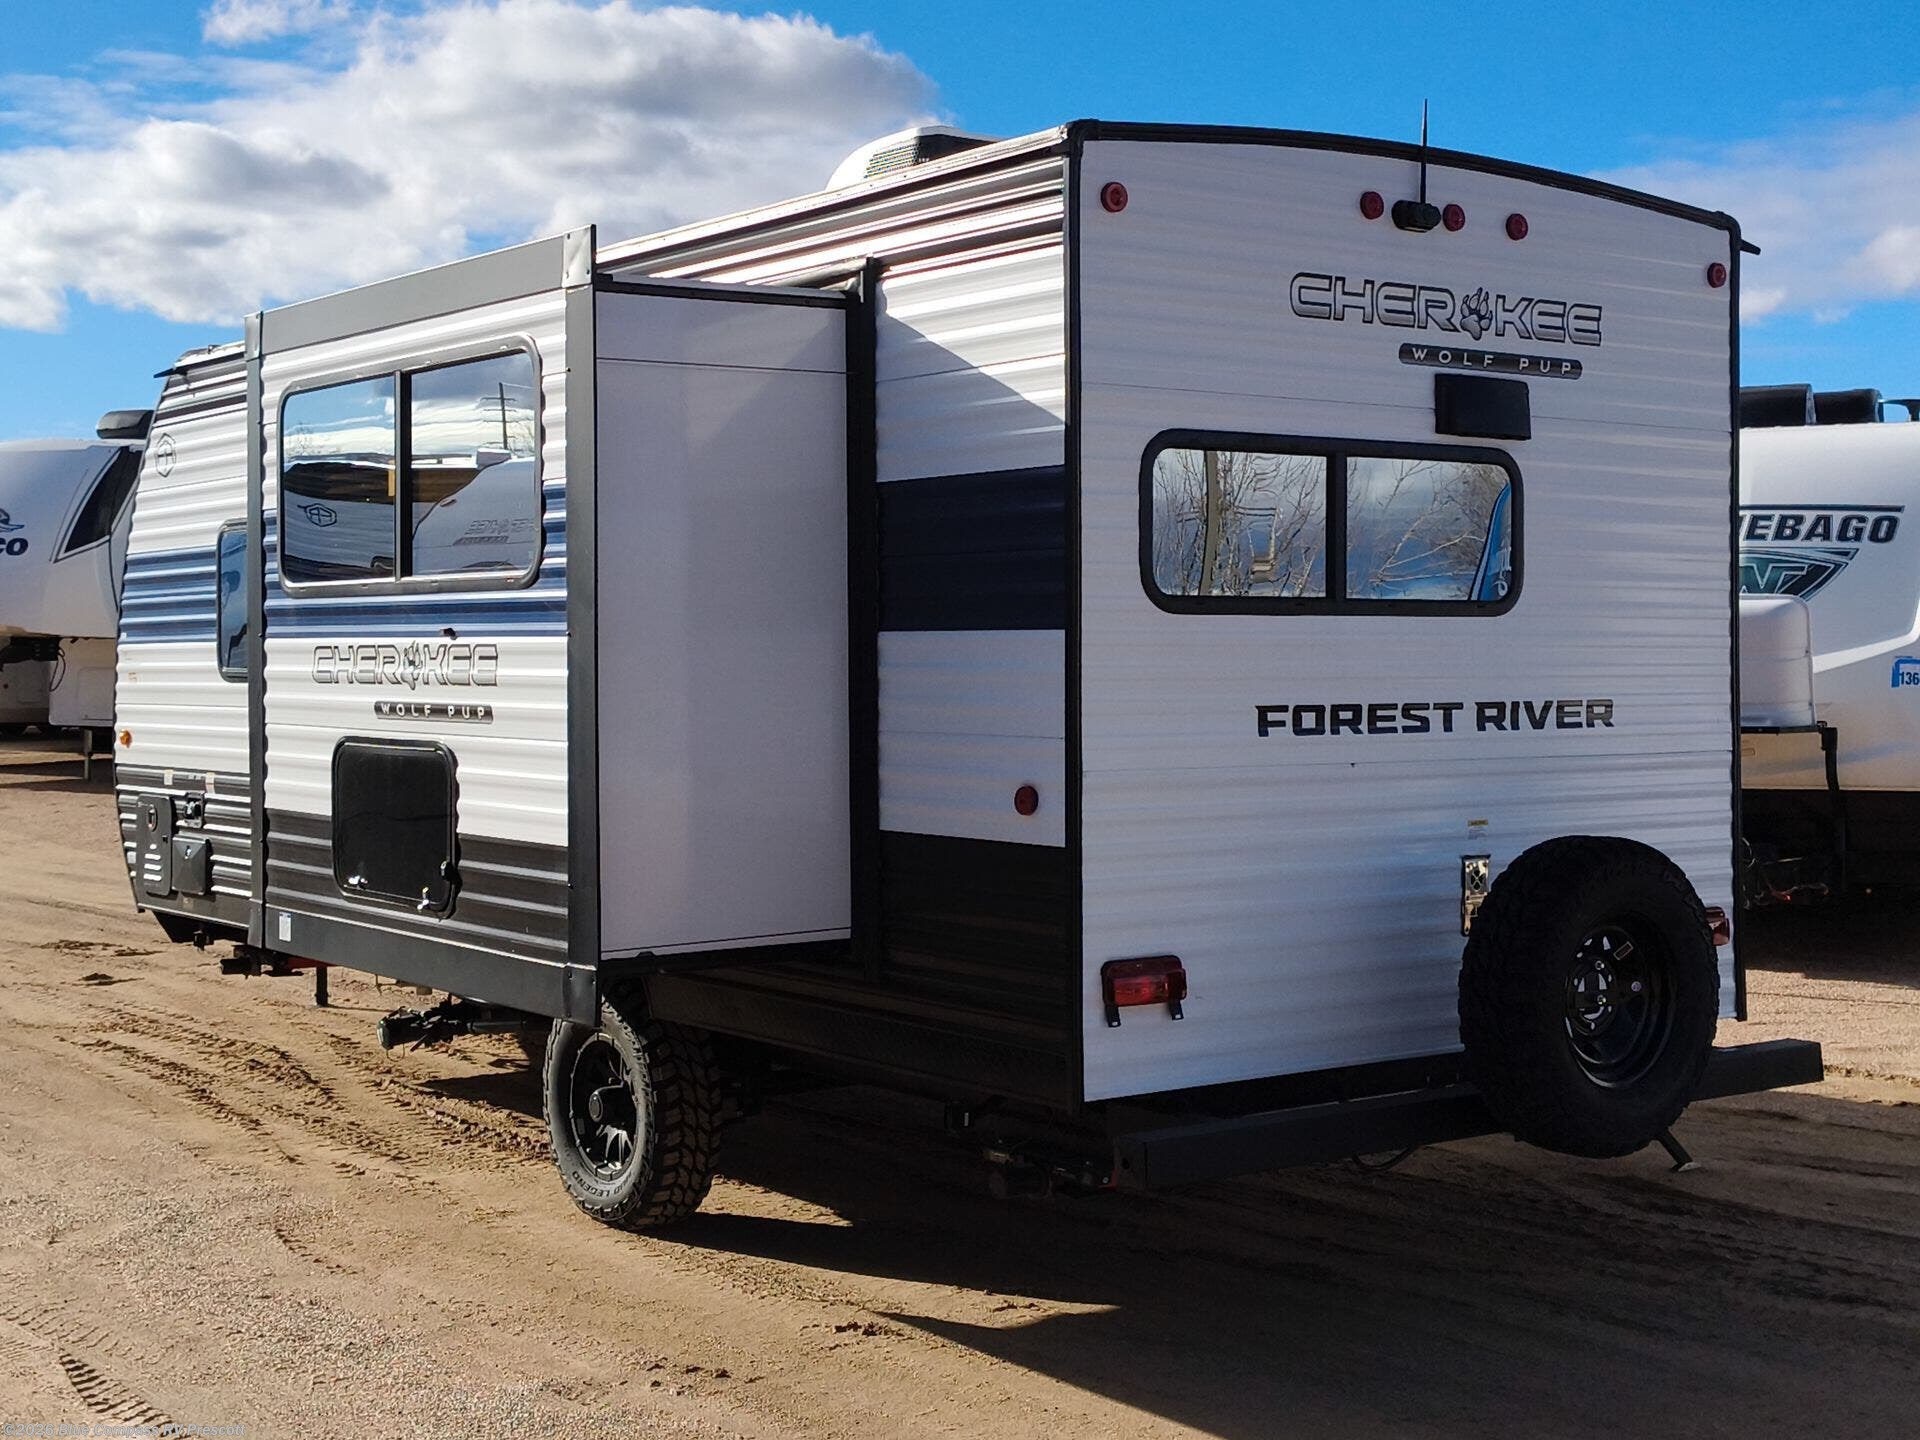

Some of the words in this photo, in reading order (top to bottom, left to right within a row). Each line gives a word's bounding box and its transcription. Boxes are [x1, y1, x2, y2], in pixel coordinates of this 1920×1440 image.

[1290, 271, 1602, 347] CHEROKEE
[1411, 347, 1495, 368] WOLF
[1518, 358, 1572, 376] PUP
[312, 641, 498, 690] CHEROKEE
[380, 703, 432, 718] WOLF
[447, 705, 485, 721] PUP
[1255, 702, 1464, 738] FOREST
[1474, 698, 1615, 732] RIVER
[572, 1170, 610, 1198] LEGEND
